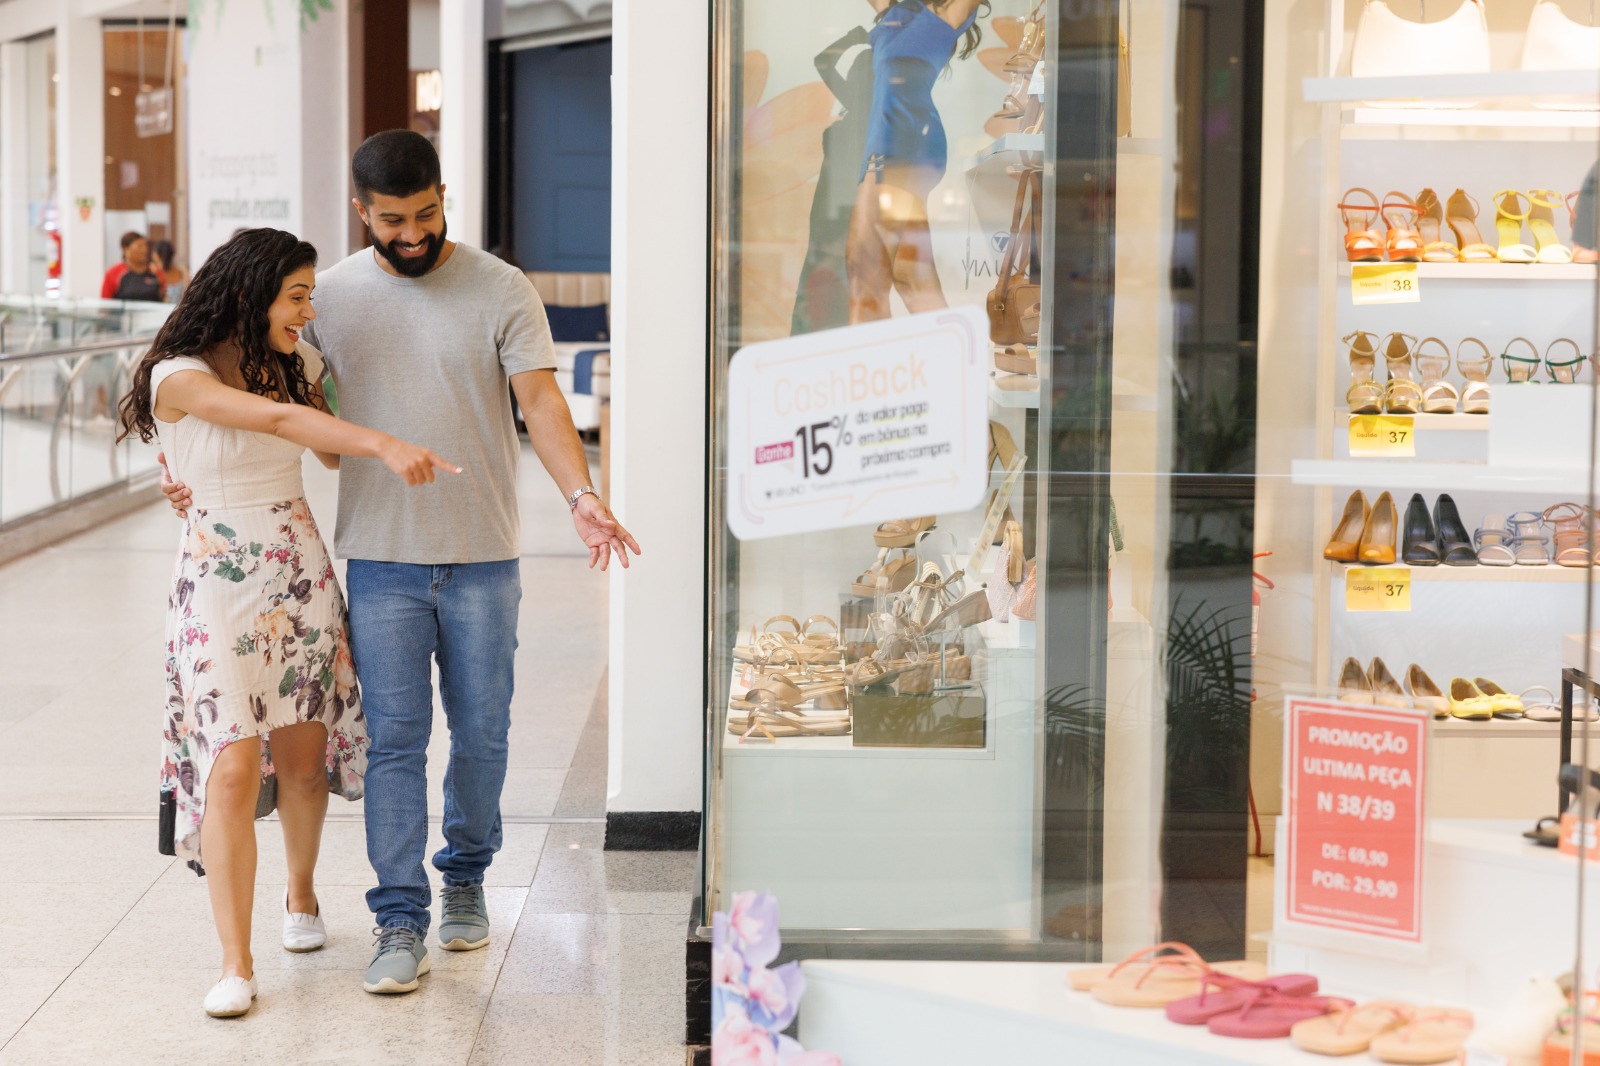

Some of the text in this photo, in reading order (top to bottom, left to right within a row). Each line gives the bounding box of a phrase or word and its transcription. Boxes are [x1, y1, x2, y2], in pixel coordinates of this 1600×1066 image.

[1393, 279, 1412, 291] 38
[773, 352, 928, 417] CashBack
[872, 405, 898, 421] valor
[898, 401, 929, 419] pago
[757, 415, 853, 478] Ganhe 15%
[1389, 431, 1407, 443] 37
[1385, 584, 1404, 596] 37
[1308, 725, 1409, 755] PROMOÇÃO
[1303, 756, 1413, 789] ULTIMA PEÇA
[1317, 790, 1396, 822] N 38/39
[1321, 842, 1347, 861] DE:
[1311, 868, 1399, 899] POR: 29,90
